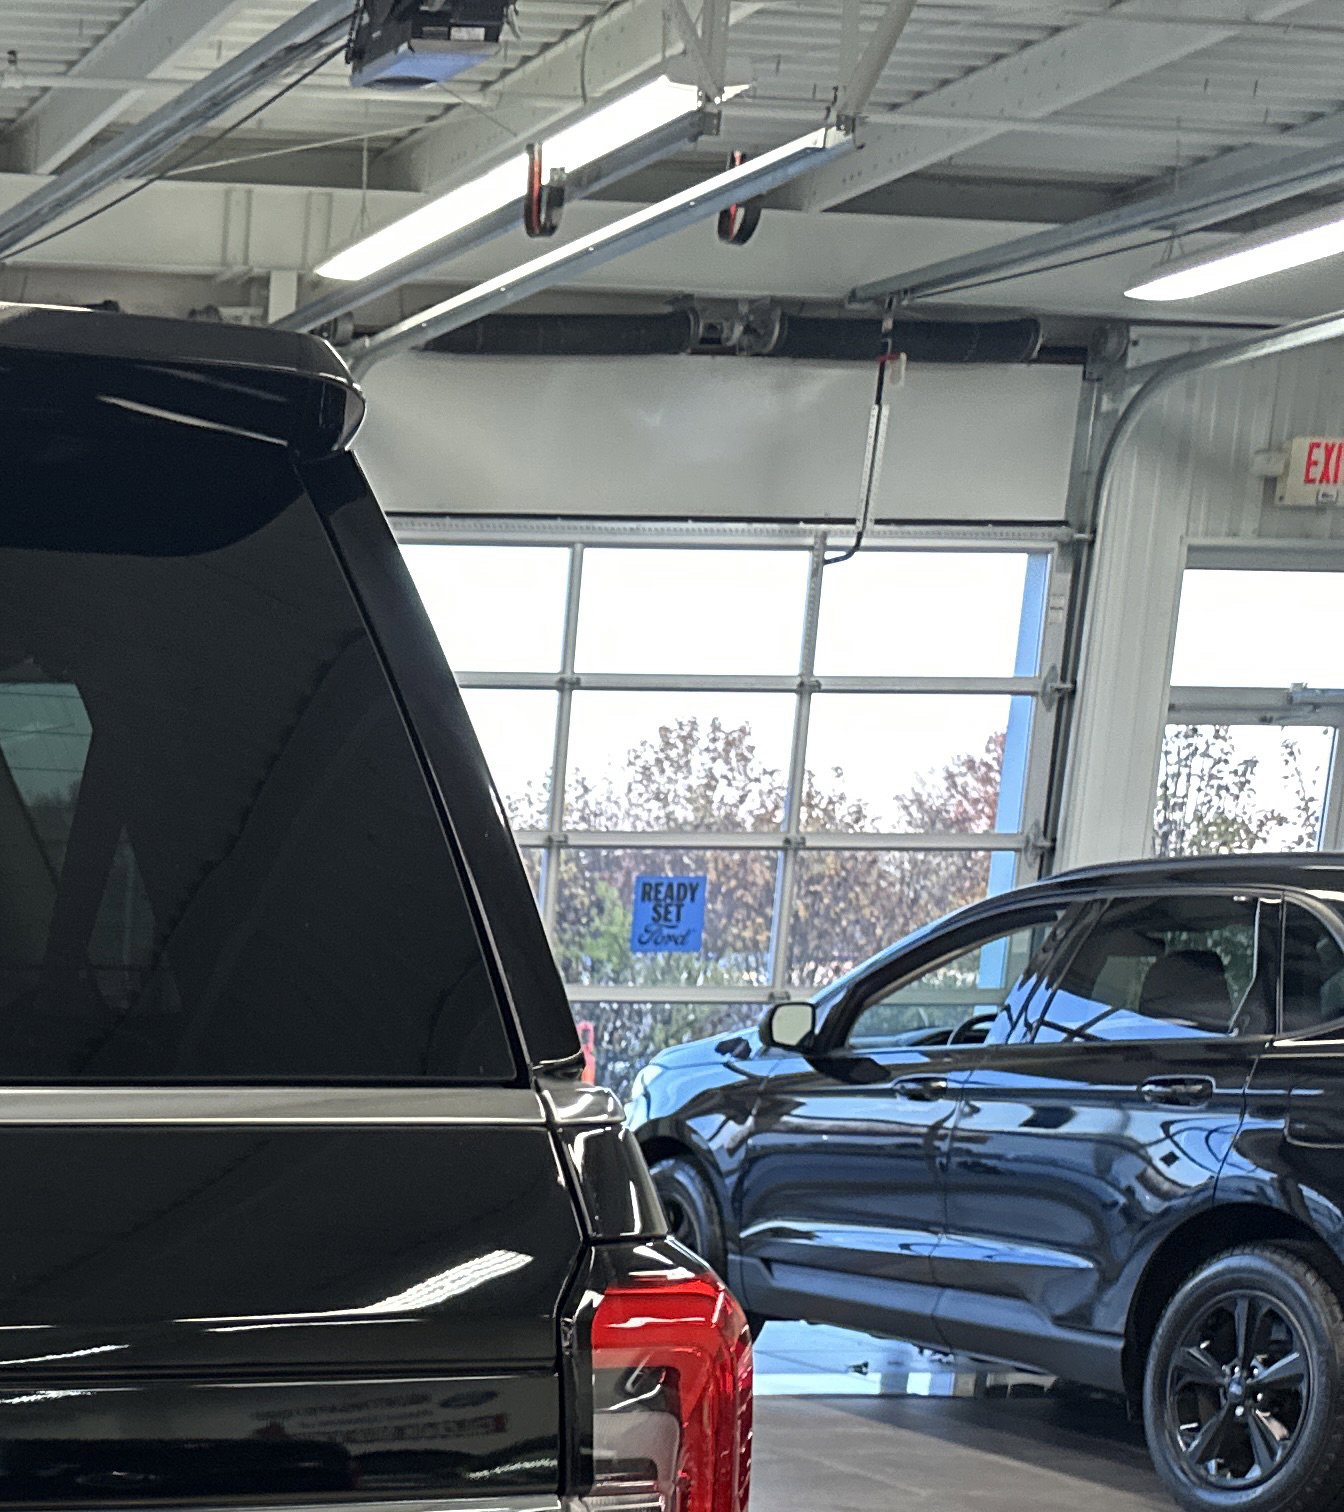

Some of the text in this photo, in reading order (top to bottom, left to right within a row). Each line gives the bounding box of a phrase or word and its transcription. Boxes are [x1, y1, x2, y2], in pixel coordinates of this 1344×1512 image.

[1304, 441, 1344, 485] EXI
[640, 881, 700, 903] READY
[651, 903, 685, 923] SET
[637, 922, 692, 946] Ford
